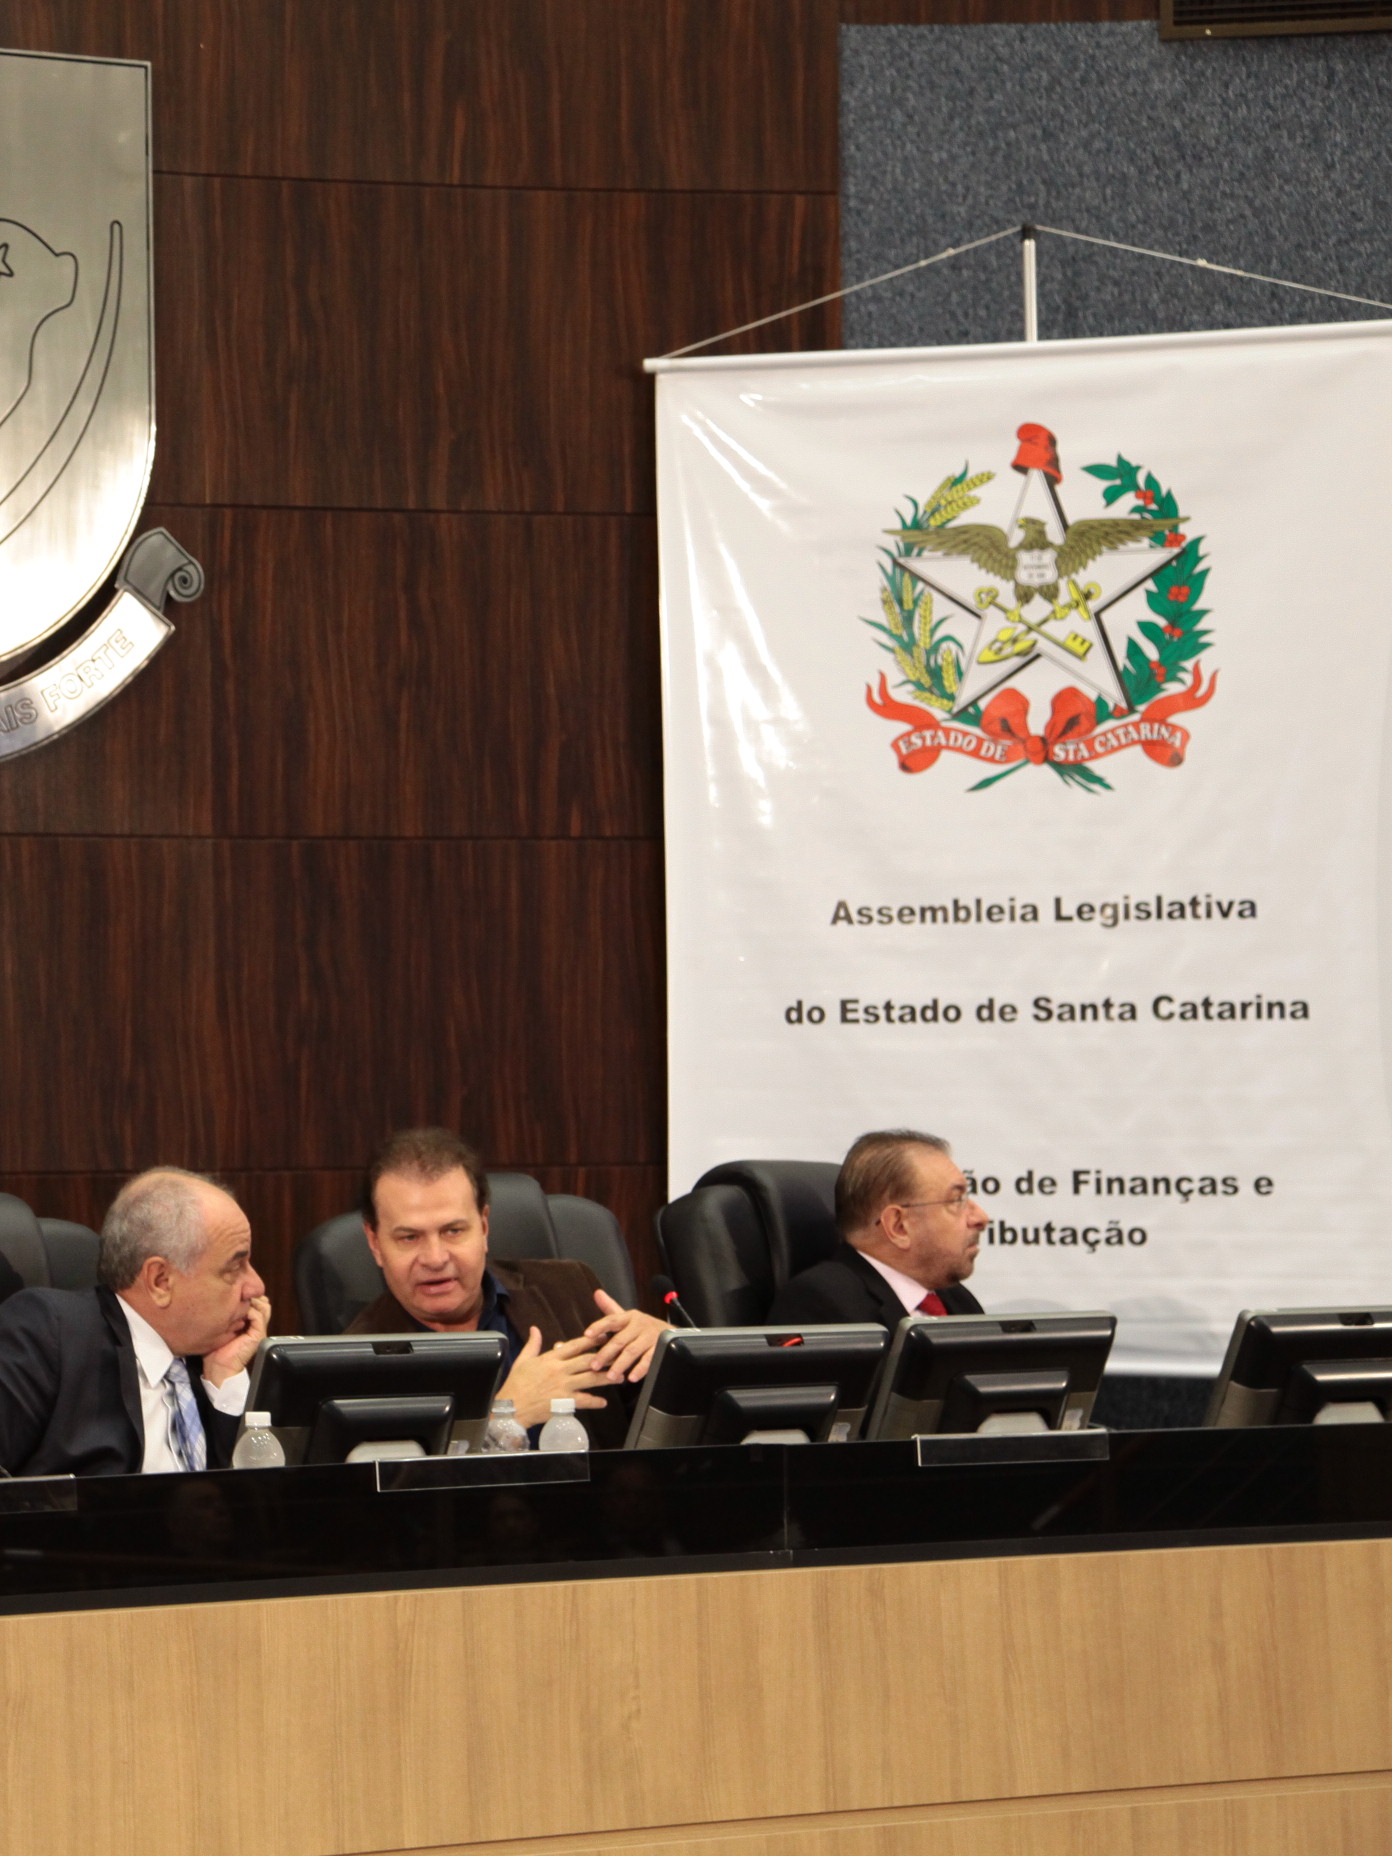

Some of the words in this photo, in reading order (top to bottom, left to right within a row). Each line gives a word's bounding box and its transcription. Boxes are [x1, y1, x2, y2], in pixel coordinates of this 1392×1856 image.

[40, 628, 135, 712] FORTE
[898, 729, 978, 755] ESTADO
[980, 742, 1007, 762] DE
[1093, 722, 1182, 752] CATARINA
[830, 897, 1039, 925] Assembleia
[1054, 894, 1257, 928] Legislativa
[784, 1000, 826, 1024] do
[839, 998, 962, 1024] Estado
[975, 998, 1018, 1022] de
[1032, 996, 1137, 1022] Santa
[1151, 994, 1309, 1021] Catarina
[1014, 1169, 1058, 1195] de
[1071, 1169, 1240, 1203] Finanças
[1254, 1175, 1275, 1196] e
